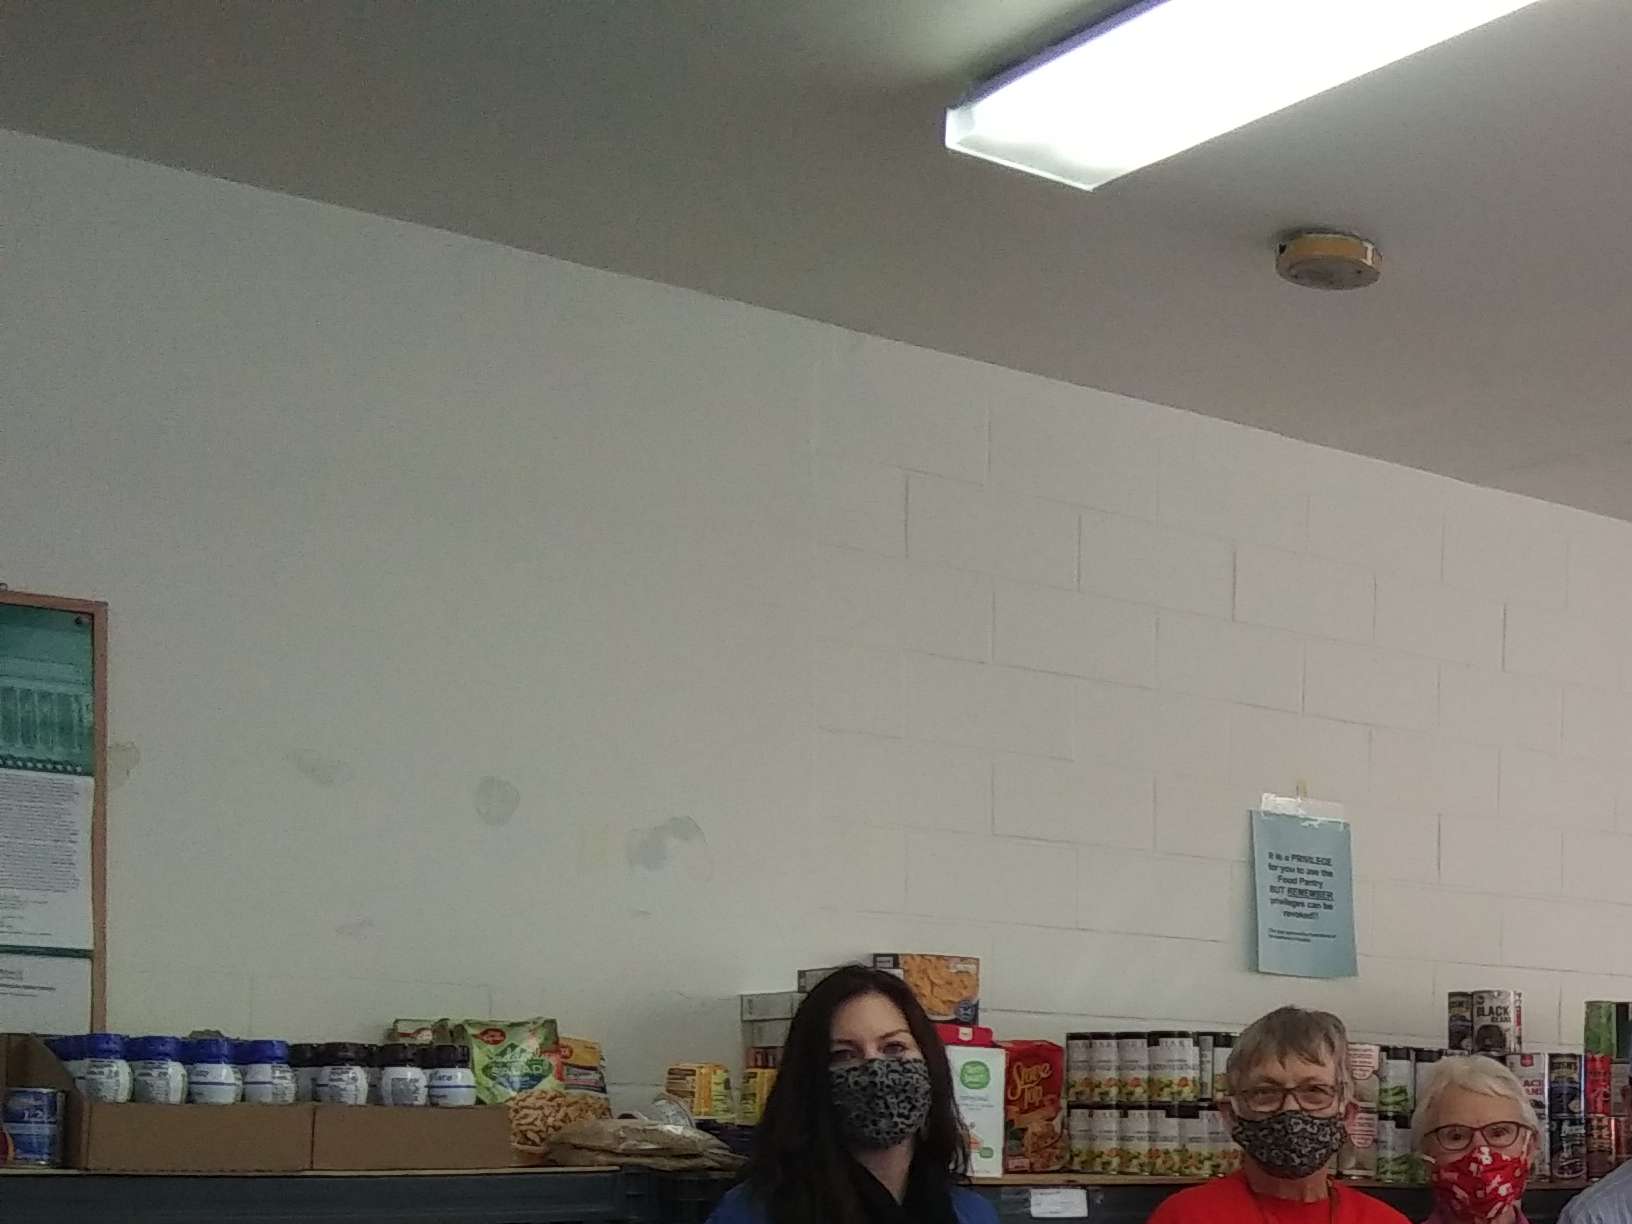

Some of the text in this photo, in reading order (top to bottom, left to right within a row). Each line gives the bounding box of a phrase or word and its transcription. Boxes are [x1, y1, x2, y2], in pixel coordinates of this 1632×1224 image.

[1291, 854, 1332, 866] PRIVILEGE
[1279, 866, 1295, 874] you
[1321, 869, 1334, 877] the
[1278, 874, 1323, 889] Food Pantry
[1269, 885, 1334, 901] BUT REMEMBER
[1323, 902, 1334, 910] be
[1476, 1005, 1510, 1017] BLACK
[1007, 1061, 1054, 1101] Stove
[1021, 1085, 1045, 1111] Top
